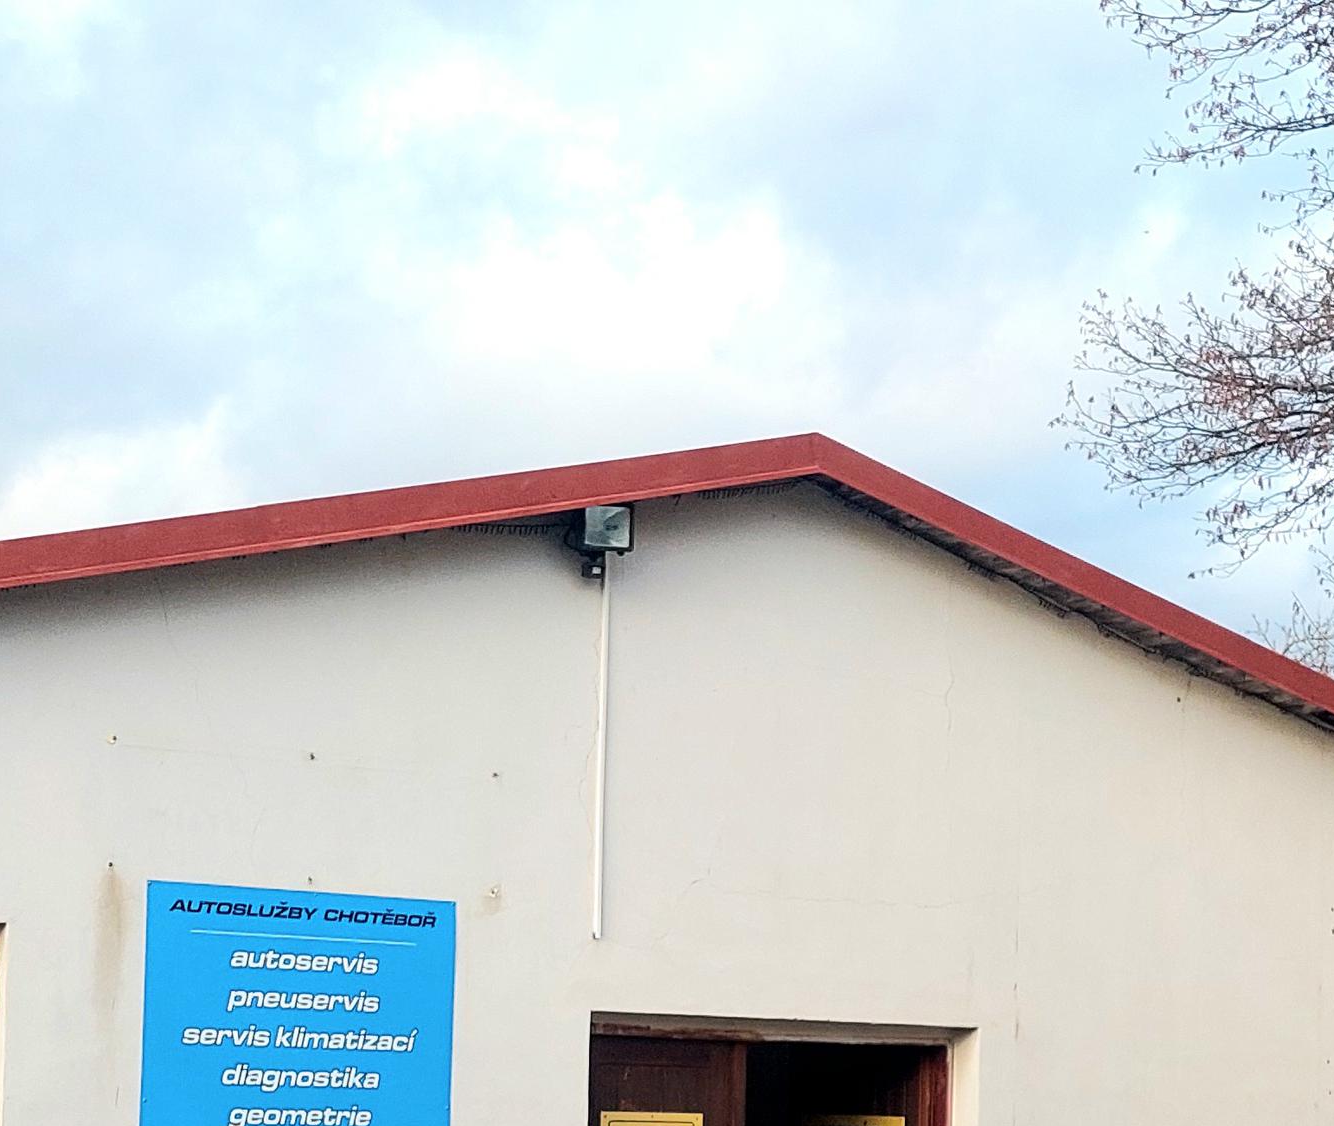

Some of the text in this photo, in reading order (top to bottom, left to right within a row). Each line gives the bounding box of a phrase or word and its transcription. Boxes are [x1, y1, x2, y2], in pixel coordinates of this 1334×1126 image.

[169, 900, 436, 928] AUTOSLUŽBY CHOTĚBOŘ
[230, 949, 379, 975] autoservis
[227, 989, 380, 1013] pneuservis
[182, 1025, 418, 1053] servis klimatizací
[221, 1064, 380, 1092] diagnostika
